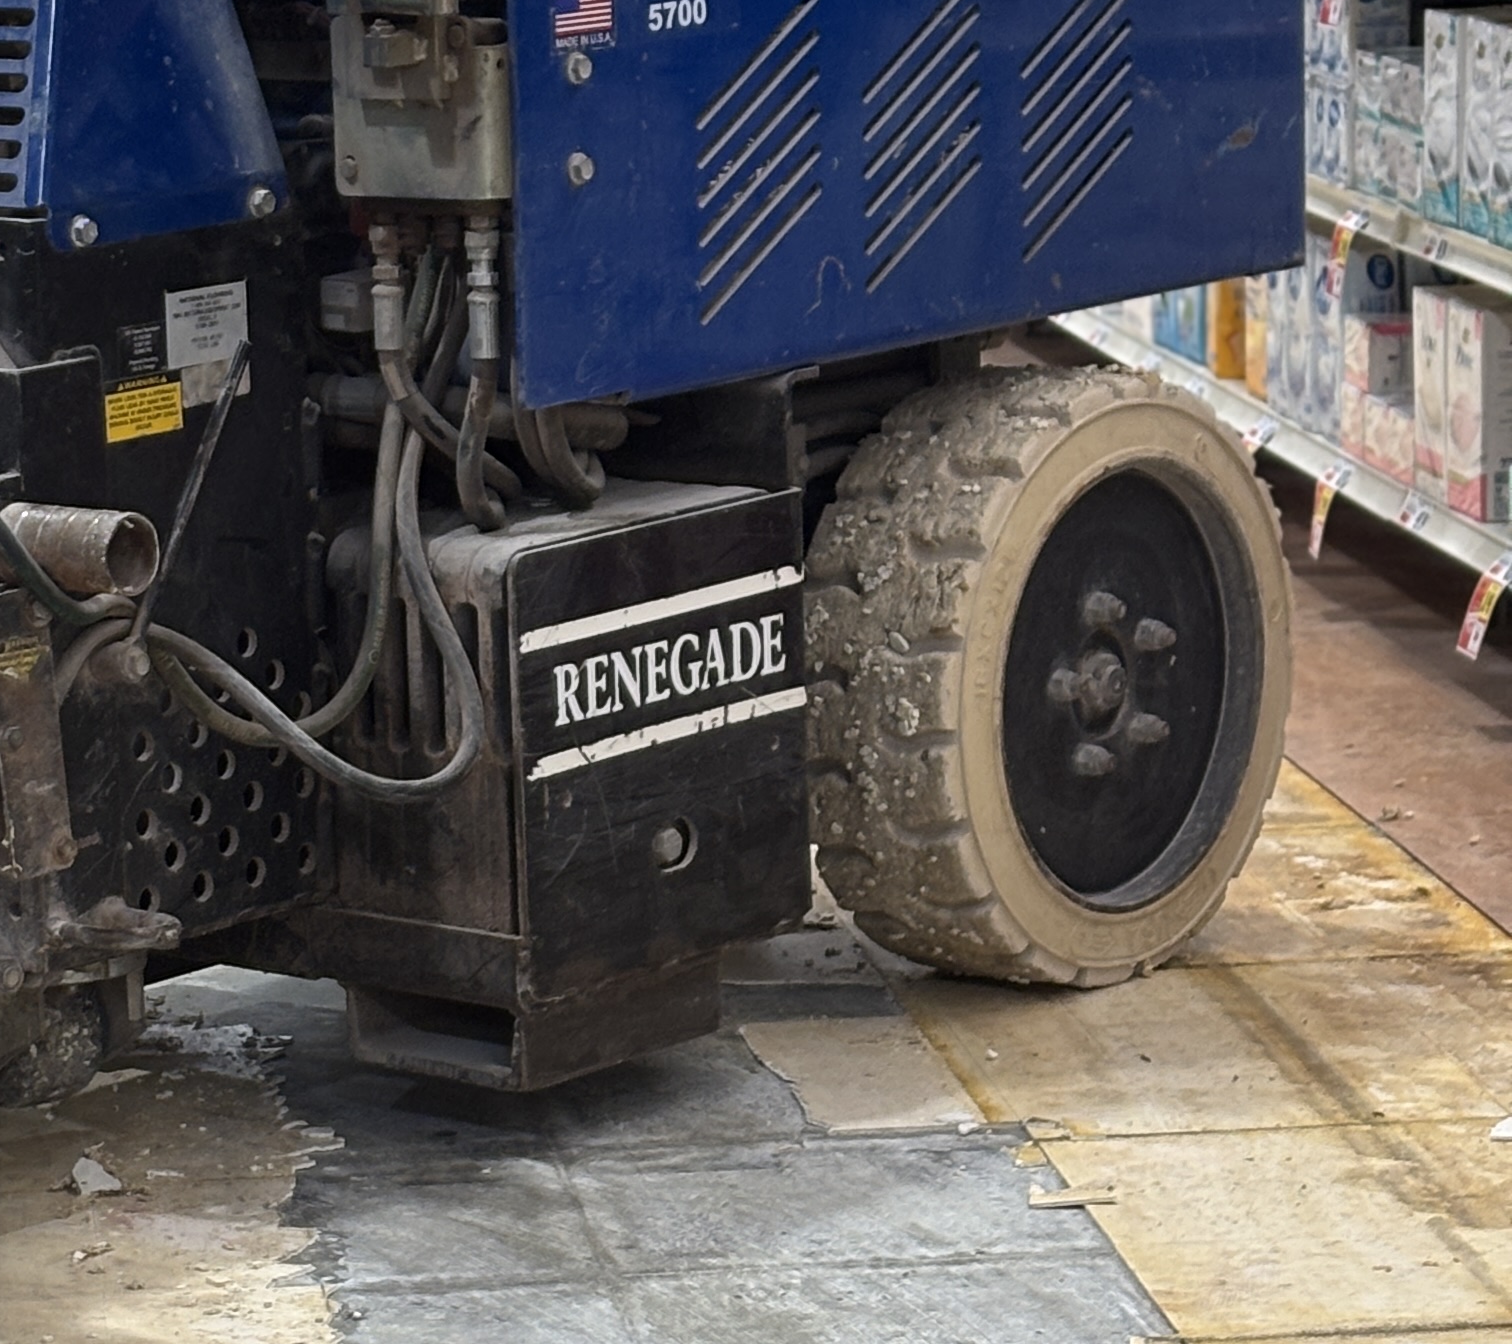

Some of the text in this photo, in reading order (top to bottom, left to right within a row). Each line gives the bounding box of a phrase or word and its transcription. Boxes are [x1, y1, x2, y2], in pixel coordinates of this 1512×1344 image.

[555, 36, 579, 48] MADE
[580, 35, 589, 46] IN
[553, 612, 786, 727] RENEGADE
